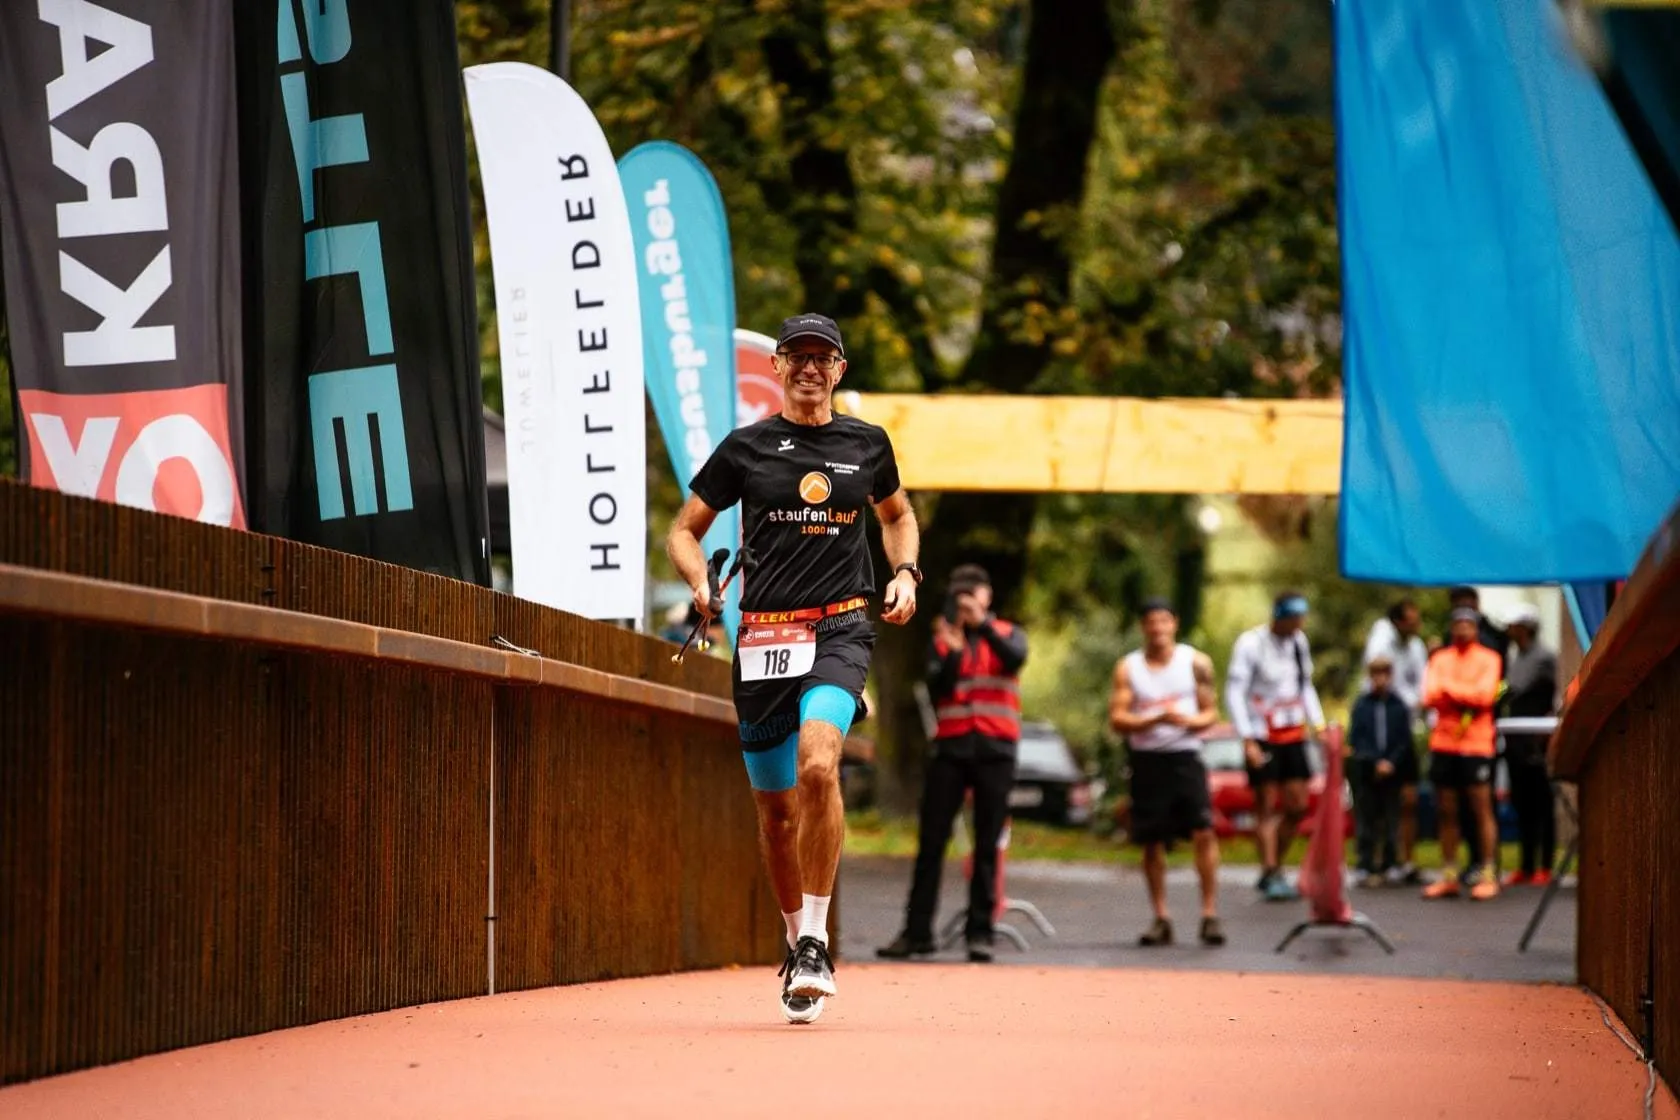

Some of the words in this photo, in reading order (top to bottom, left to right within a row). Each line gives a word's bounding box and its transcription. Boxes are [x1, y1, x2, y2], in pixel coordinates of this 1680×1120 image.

[768, 506, 858, 525] staufenlauf
[759, 612, 795, 623] LEKI
[763, 648, 791, 676] 118
